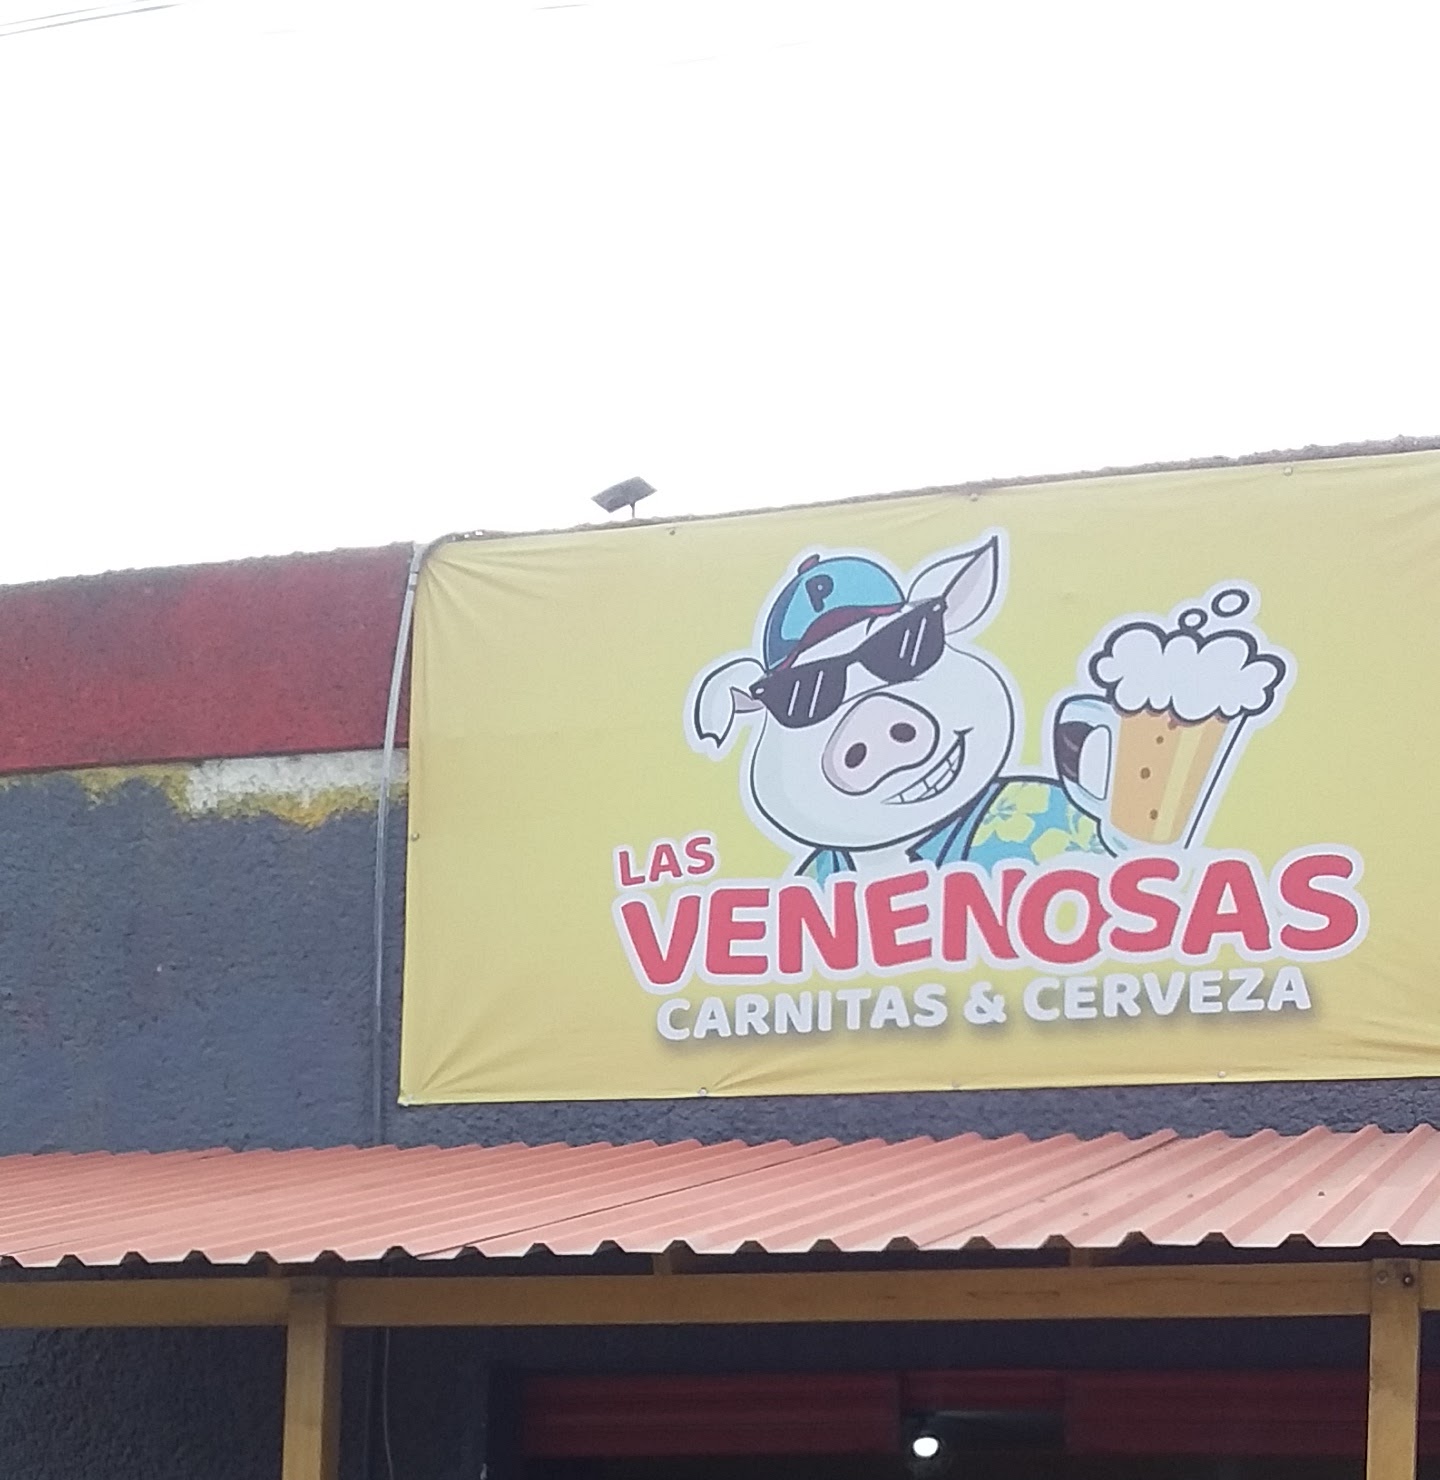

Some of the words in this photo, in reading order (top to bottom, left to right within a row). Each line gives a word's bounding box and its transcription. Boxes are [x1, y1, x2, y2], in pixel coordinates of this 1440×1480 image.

[806, 575, 834, 612] P
[619, 837, 715, 886] LAS
[620, 854, 1360, 984] VENENOSAS
[656, 984, 949, 1041] CARNITAS
[963, 982, 1007, 1024] &
[1024, 967, 1312, 1020] CERVEZA
